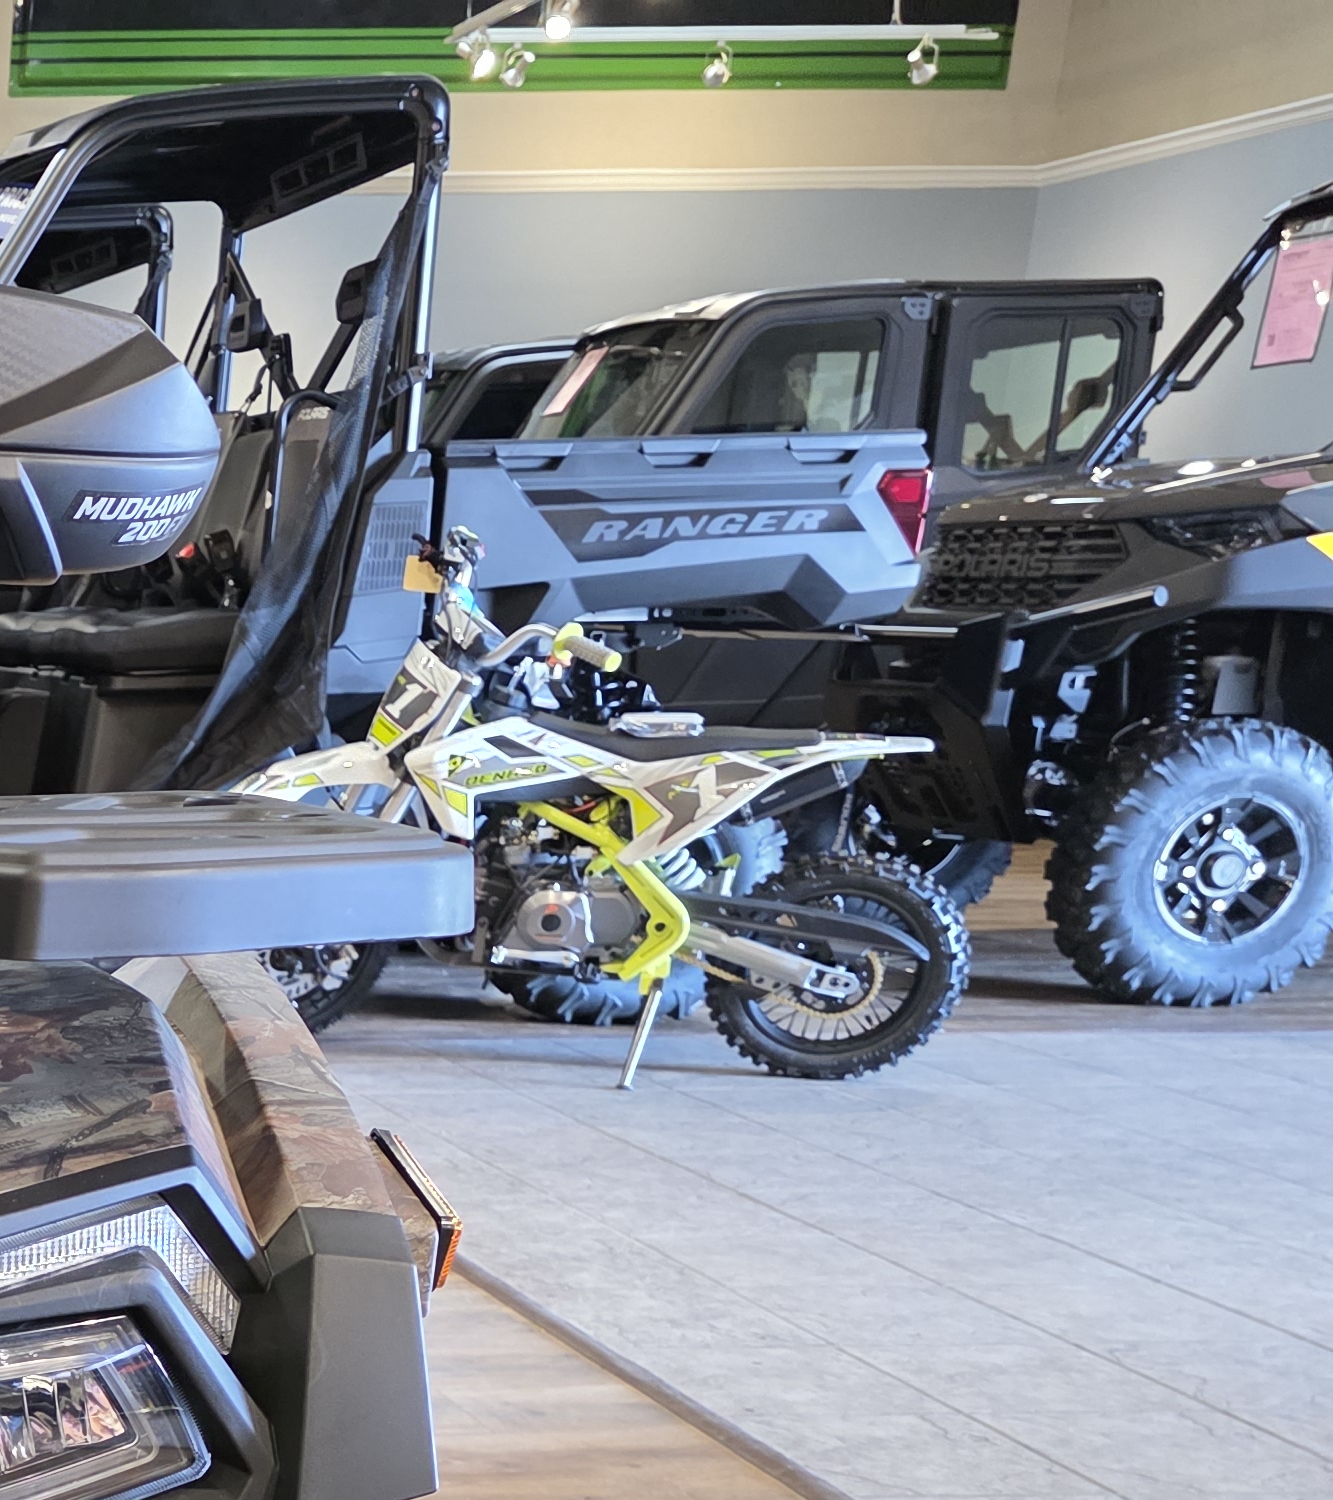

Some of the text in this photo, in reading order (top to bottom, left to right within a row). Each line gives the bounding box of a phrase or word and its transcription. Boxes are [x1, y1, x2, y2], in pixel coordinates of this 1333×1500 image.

[72, 487, 203, 521] MUDHAWK
[581, 508, 831, 544] RANGER
[464, 763, 548, 790] DENAO
